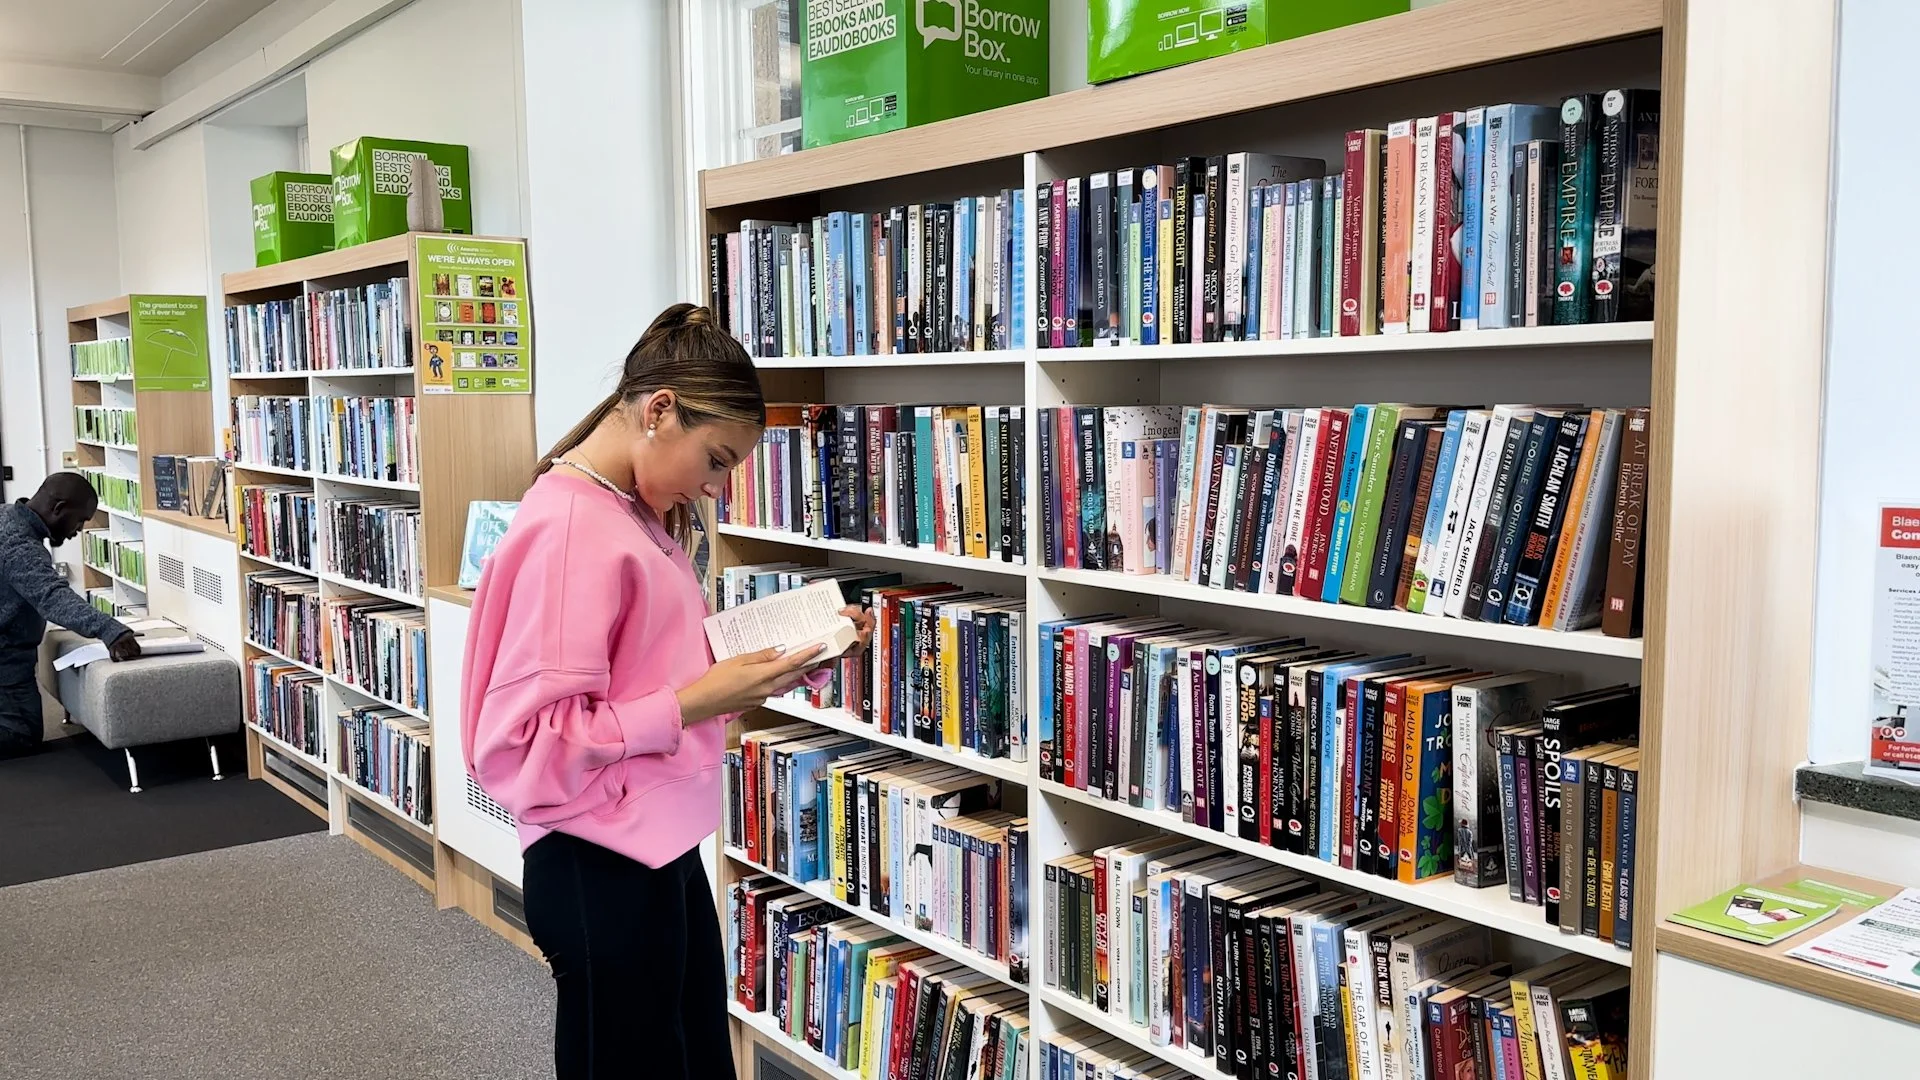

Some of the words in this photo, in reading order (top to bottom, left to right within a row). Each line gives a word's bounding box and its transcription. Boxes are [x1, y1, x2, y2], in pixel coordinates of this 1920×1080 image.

[809, 11, 856, 40] EBOOKS
[859, 3, 883, 25] AND
[965, 0, 1040, 39] Borrow
[1158, 10, 1176, 19] BORROW
[810, 19, 895, 59] EAUDIOBOOKS
[964, 28, 1011, 64] Box.
[965, 64, 981, 75] Your
[982, 66, 1003, 80] library
[1005, 71, 1011, 80] in
[1012, 74, 1025, 82] one
[1026, 76, 1040, 85] app.
[374, 152, 427, 162] BORROW
[1421, 143, 1429, 159] TO
[287, 184, 332, 194] BORROW
[341, 173, 361, 189] Borrow
[1209, 179, 1217, 198] The
[1419, 162, 1428, 206] REASON
[260, 203, 276, 217] Borrow
[288, 203, 331, 212] EBOOKS
[1175, 184, 1185, 213] TERRY
[1352, 195, 1360, 225] Vaddey
[1560, 161, 1578, 240] EMPIRE
[1600, 173, 1615, 239] EMPIRE
[1209, 200, 1217, 238] Cornish
[1417, 208, 1426, 236] WHY
[1175, 214, 1185, 267] PRATCHETT
[1206, 239, 1216, 264] Lady
[428, 255, 455, 263] WE'RE
[457, 256, 490, 265] ALWAYS
[491, 258, 515, 266] OPEN
[1144, 256, 1153, 275] THE
[1144, 276, 1153, 307] TRUTH
[1232, 268, 1240, 304] NICOLA
[138, 309, 155, 317] you'll
[151, 302, 177, 310] greatest
[1143, 426, 1178, 438] Imogen
[1375, 428, 1386, 451] Kate
[1520, 440, 1538, 485] DOUBLE
[1634, 439, 1646, 458] AT
[1207, 444, 1224, 520] HEAVENFIELD
[1250, 473, 1258, 491] VICTOR
[1262, 453, 1277, 496] DUNBAR
[1319, 432, 1341, 515] NETHERWOOD
[1367, 453, 1380, 493] Saunders
[1545, 445, 1571, 493] LACHLAN
[972, 474, 980, 498] Hush
[1618, 462, 1631, 507] Elizabeth
[1628, 462, 1644, 510] BREAK
[1247, 492, 1256, 519] ROUSSEAU
[1362, 499, 1372, 518] WILD
[1535, 493, 1558, 528] SMITH
[1464, 518, 1478, 544] JACK
[1504, 495, 1524, 545] NOTHING
[1614, 509, 1626, 543] Speller
[1625, 514, 1639, 533] OF
[1204, 539, 1215, 560] ROSS
[1309, 517, 1323, 565] SANDERSON
[1356, 522, 1368, 549] YOUNG
[1492, 547, 1507, 585] SHERWOOD
[1622, 538, 1637, 568] DAY
[1349, 552, 1362, 591] BOHEMIANS
[1452, 546, 1470, 596] SHEFFIELD
[1064, 664, 1073, 696] AWARD
[1247, 688, 1256, 718] BRAD
[1366, 706, 1375, 730] THE
[1406, 709, 1416, 740] MUM
[1888, 744, 1900, 752] For
[1146, 754, 1154, 785] STYLES
[1363, 733, 1374, 797] ASSISTANT
[1404, 754, 1414, 781] DAD
[1503, 764, 1512, 782] E.C.
[1543, 738, 1561, 809] SPOILS
[860, 805, 865, 814] GJ
[1379, 778, 1387, 820] TROPPER
[1386, 780, 1394, 823] JONATHAN
[1505, 784, 1514, 808] TUBB
[1406, 794, 1416, 834] JOANNA
[1507, 816, 1515, 840] STAR
[1509, 843, 1518, 871] FLIGHT
[1602, 860, 1613, 883] GRIM
[1601, 884, 1612, 911] DEATH
[1376, 956, 1388, 978] DICK
[1216, 975, 1224, 1005] RUTH
[1353, 981, 1363, 1001] THE
[1379, 980, 1391, 1005] WOLF
[1217, 1007, 1225, 1036] WARE
[1356, 1005, 1366, 1028] GAP
[1359, 1031, 1369, 1046] OF
[1362, 1050, 1371, 1075] TIME
